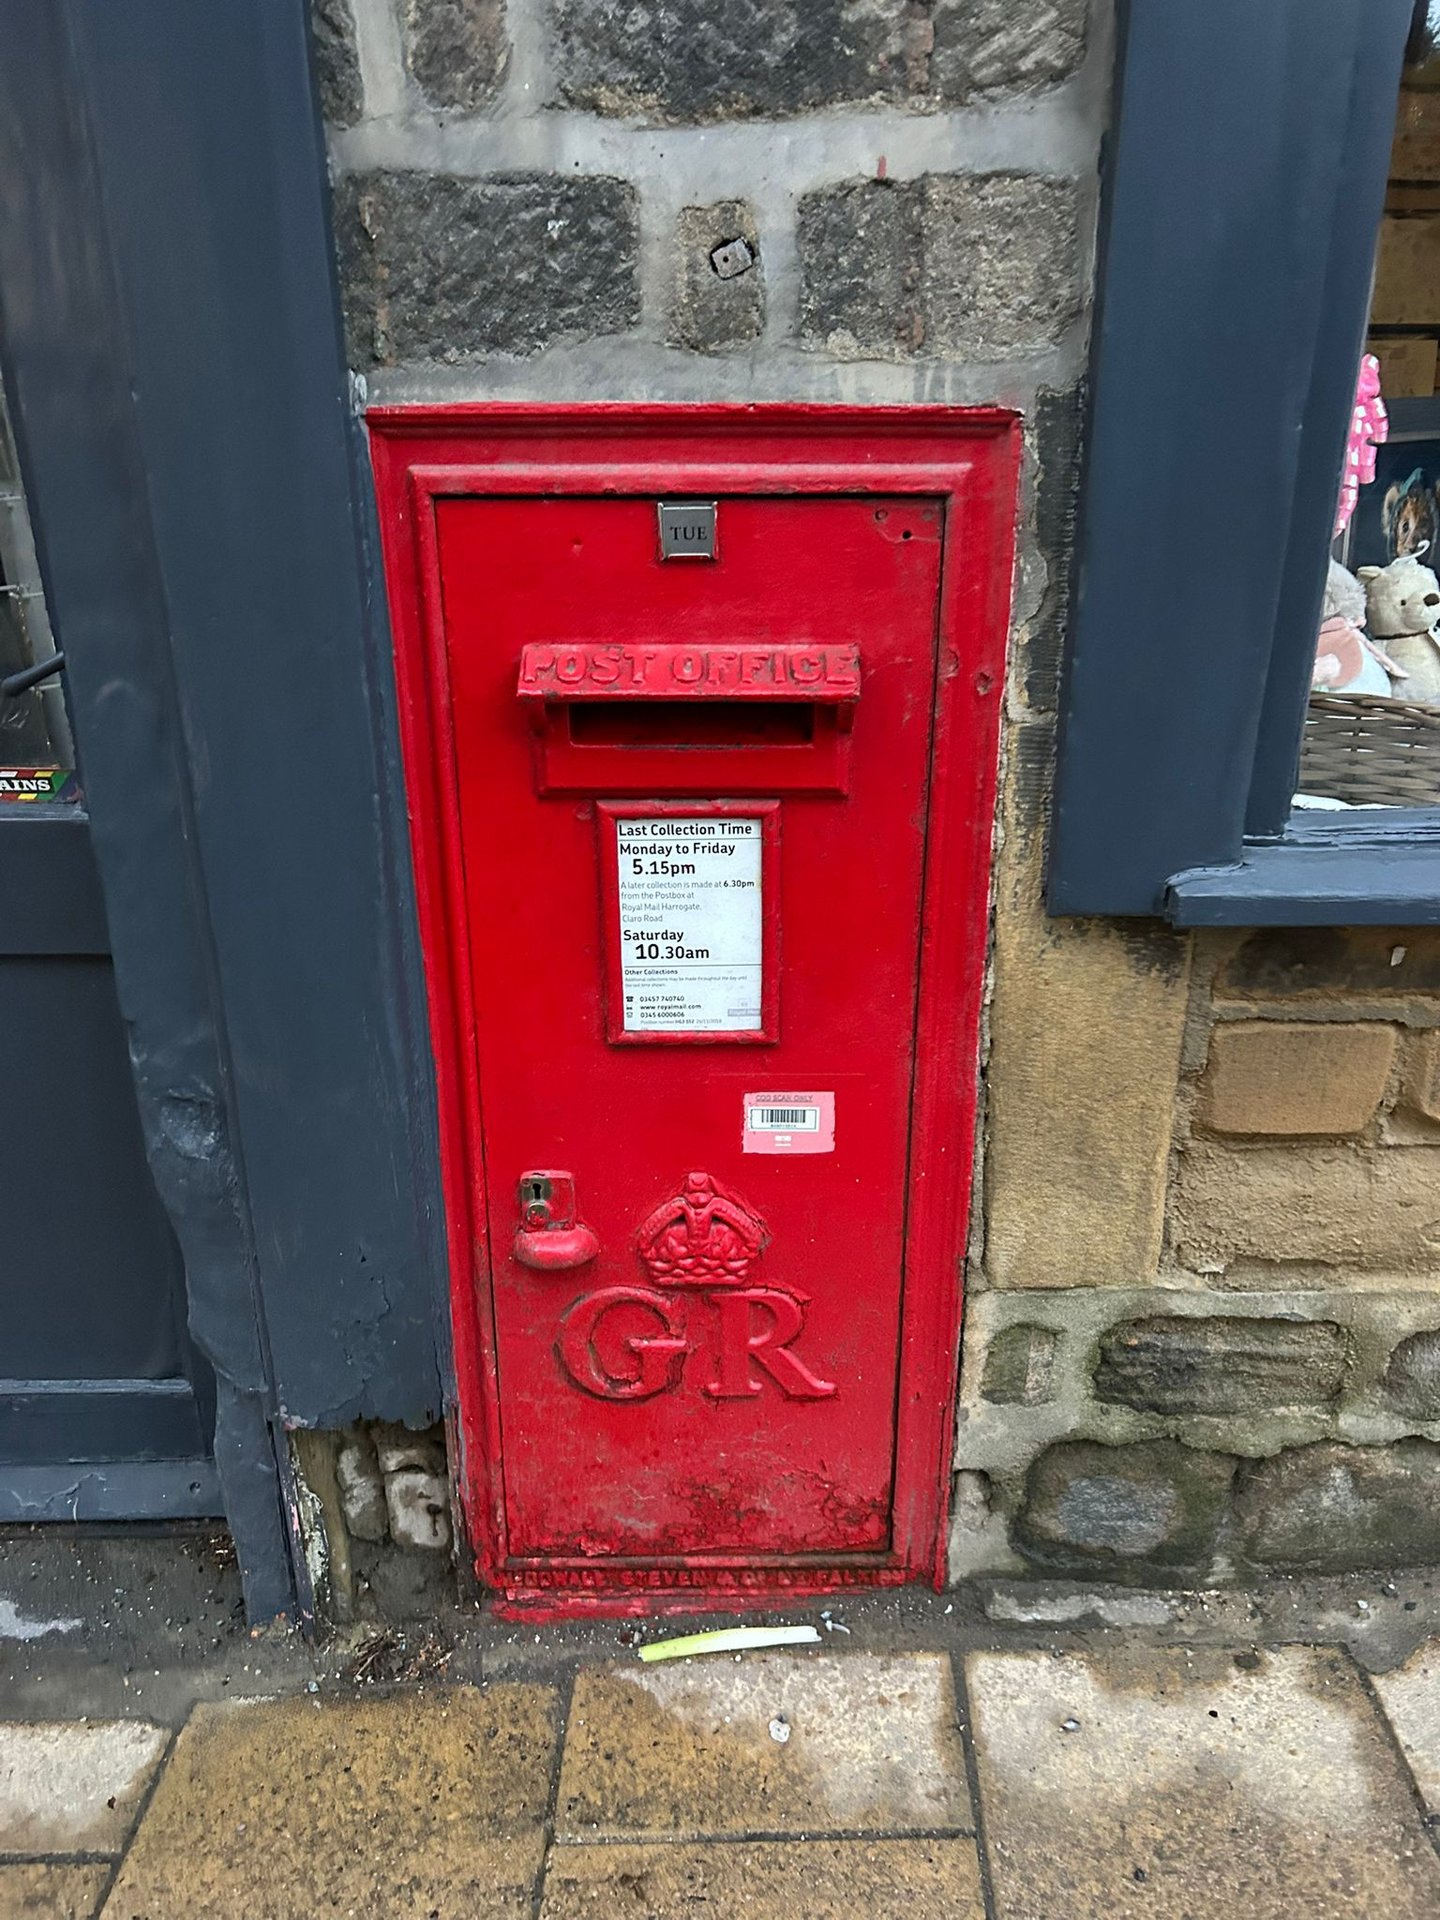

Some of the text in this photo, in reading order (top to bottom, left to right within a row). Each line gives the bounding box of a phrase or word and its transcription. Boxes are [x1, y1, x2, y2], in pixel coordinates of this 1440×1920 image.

[669, 525, 708, 541] TUE
[522, 650, 857, 684] POST OFFICE
[618, 823, 752, 836] Last Collection Time
[619, 842, 736, 857] Monday to Friday
[632, 858, 695, 877] 5.15pm
[646, 881, 683, 889] collection
[713, 880, 723, 888] at
[723, 880, 755, 888] 6.30pm
[621, 891, 695, 899] from the Postbox at
[622, 903, 643, 912] Royal
[644, 902, 660, 910] Mail
[622, 914, 663, 923] Claro Road
[624, 929, 684, 942] Saturday
[635, 944, 710, 960] 10.30am
